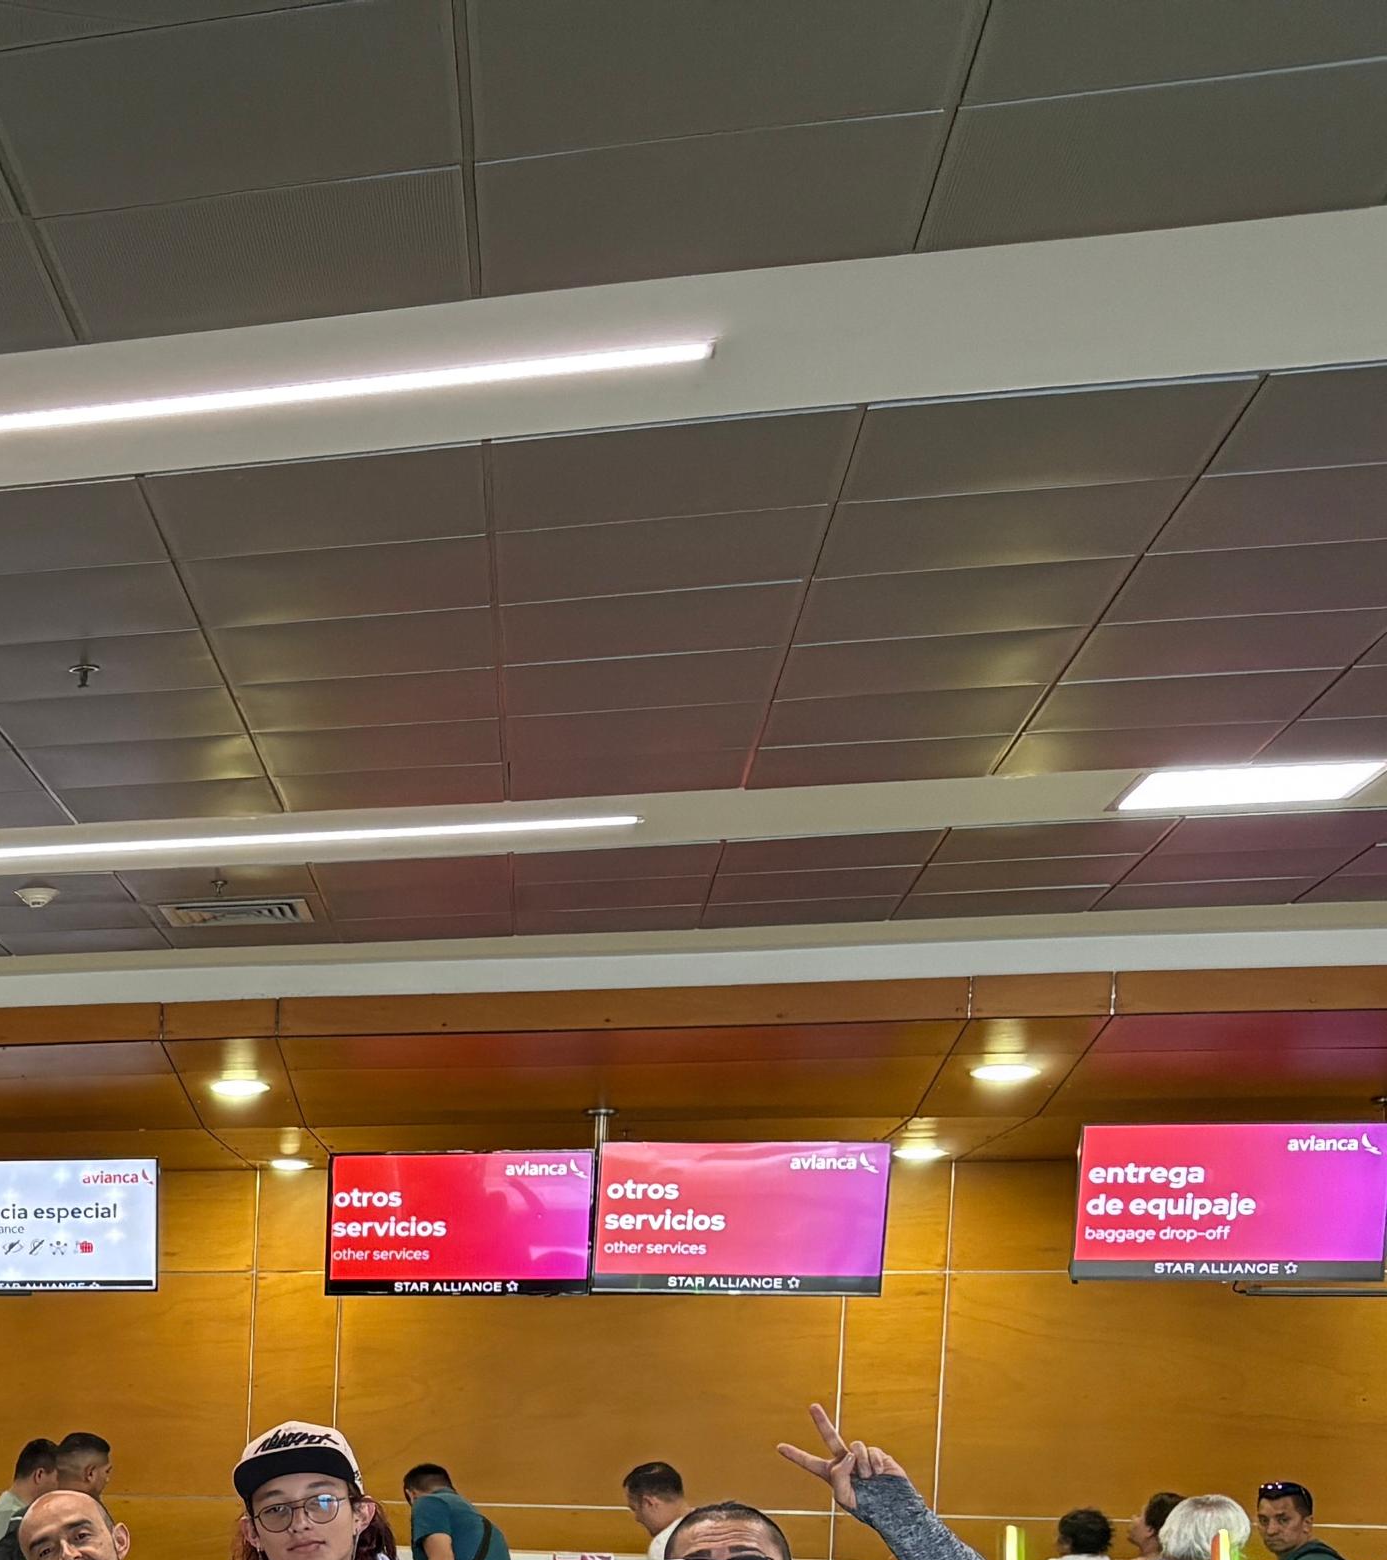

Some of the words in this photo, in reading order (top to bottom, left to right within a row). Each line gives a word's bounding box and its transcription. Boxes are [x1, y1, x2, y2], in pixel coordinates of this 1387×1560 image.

[1287, 1135, 1359, 1152] avianca
[505, 1160, 567, 1177] avianca
[790, 1153, 857, 1172] avianca
[82, 1169, 138, 1185] avianca
[1088, 1162, 1205, 1188] entrega
[333, 1187, 402, 1208] otros
[607, 1179, 679, 1201] otros
[33, 1203, 117, 1224] especial
[1085, 1193, 1124, 1216] de
[1128, 1192, 1257, 1220] equipaje
[333, 1215, 446, 1238] servicios
[605, 1209, 725, 1231] servicios
[1084, 1226, 1155, 1243] baggage
[1159, 1225, 1231, 1241] drop-off
[333, 1247, 370, 1262] other
[373, 1247, 429, 1262] services
[604, 1240, 643, 1255] other
[646, 1241, 707, 1255] services
[1154, 1262, 1195, 1275] STAR
[1199, 1262, 1279, 1275] ALLIANCE
[394, 1281, 429, 1293] STAR
[433, 1281, 502, 1293] ALLIANCE
[667, 1276, 707, 1288] STAR
[709, 1277, 782, 1290] ALLIANCE
